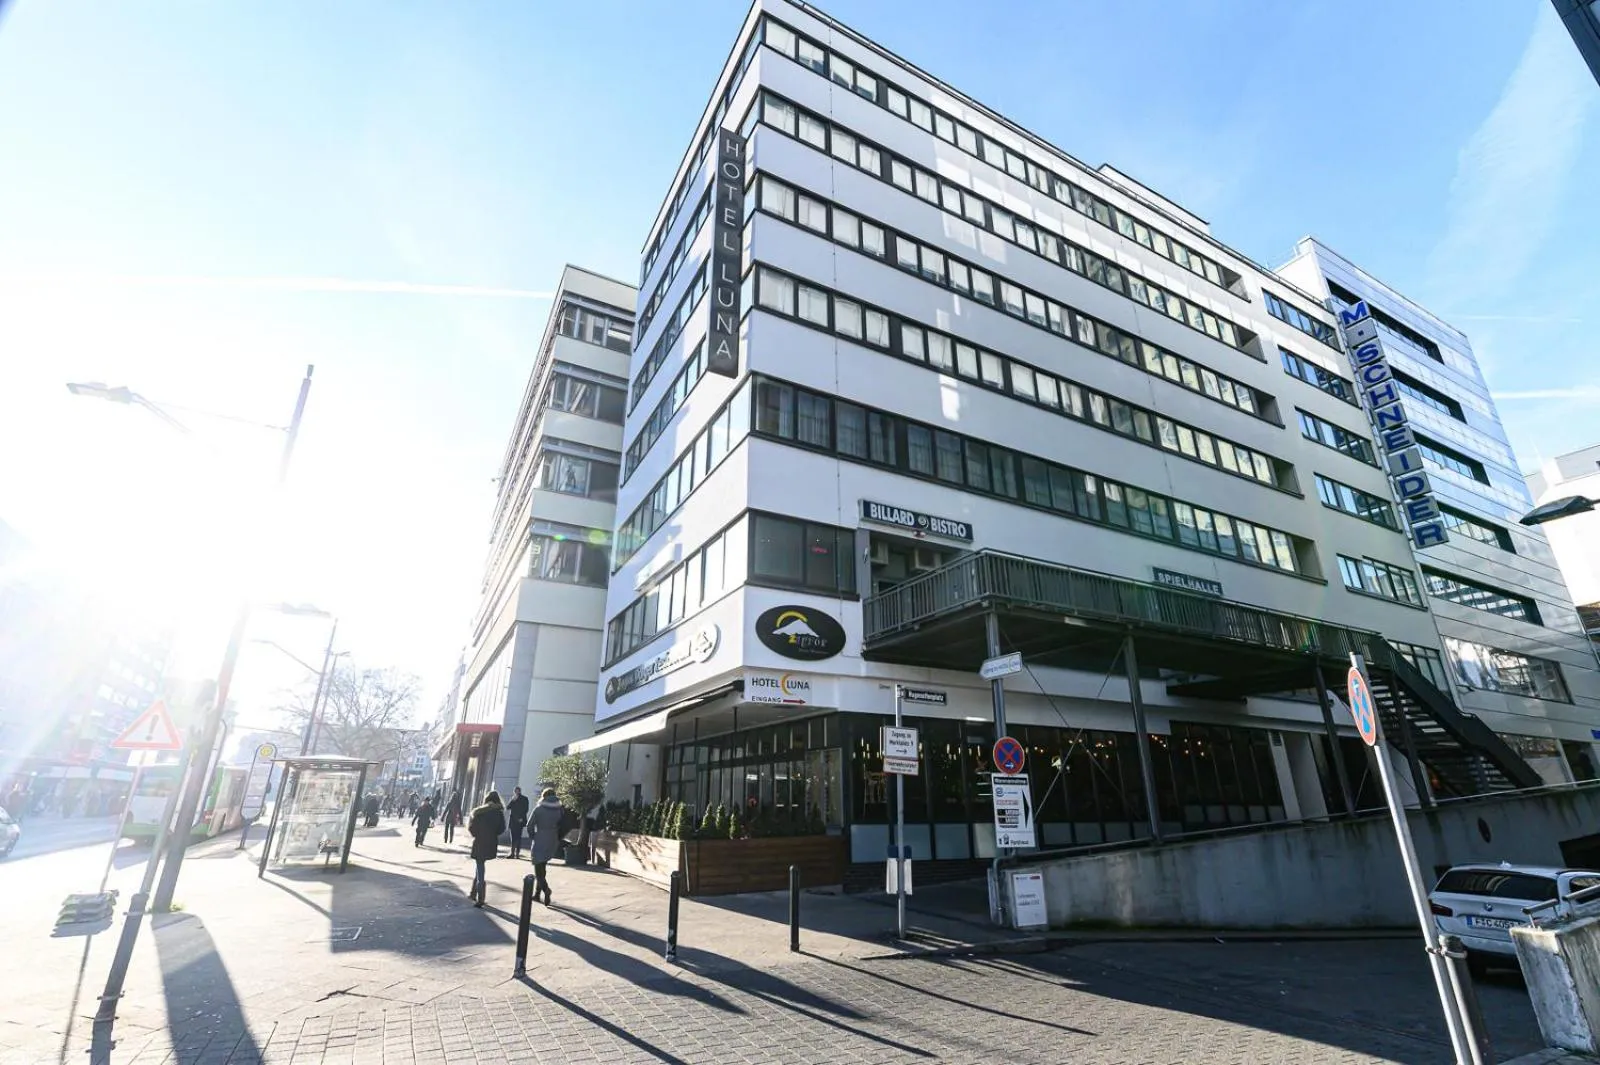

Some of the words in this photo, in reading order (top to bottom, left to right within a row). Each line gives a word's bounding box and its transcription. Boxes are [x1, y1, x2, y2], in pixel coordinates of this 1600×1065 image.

[722, 139, 740, 251] HOTEL
[716, 263, 734, 360] LUNA
[1356, 343, 1443, 547] SCHNEIDER
[869, 503, 915, 526] BILLARD
[931, 518, 966, 537] BISTRO
[751, 677, 780, 688] HOTEL
[786, 680, 810, 689] LUNA
